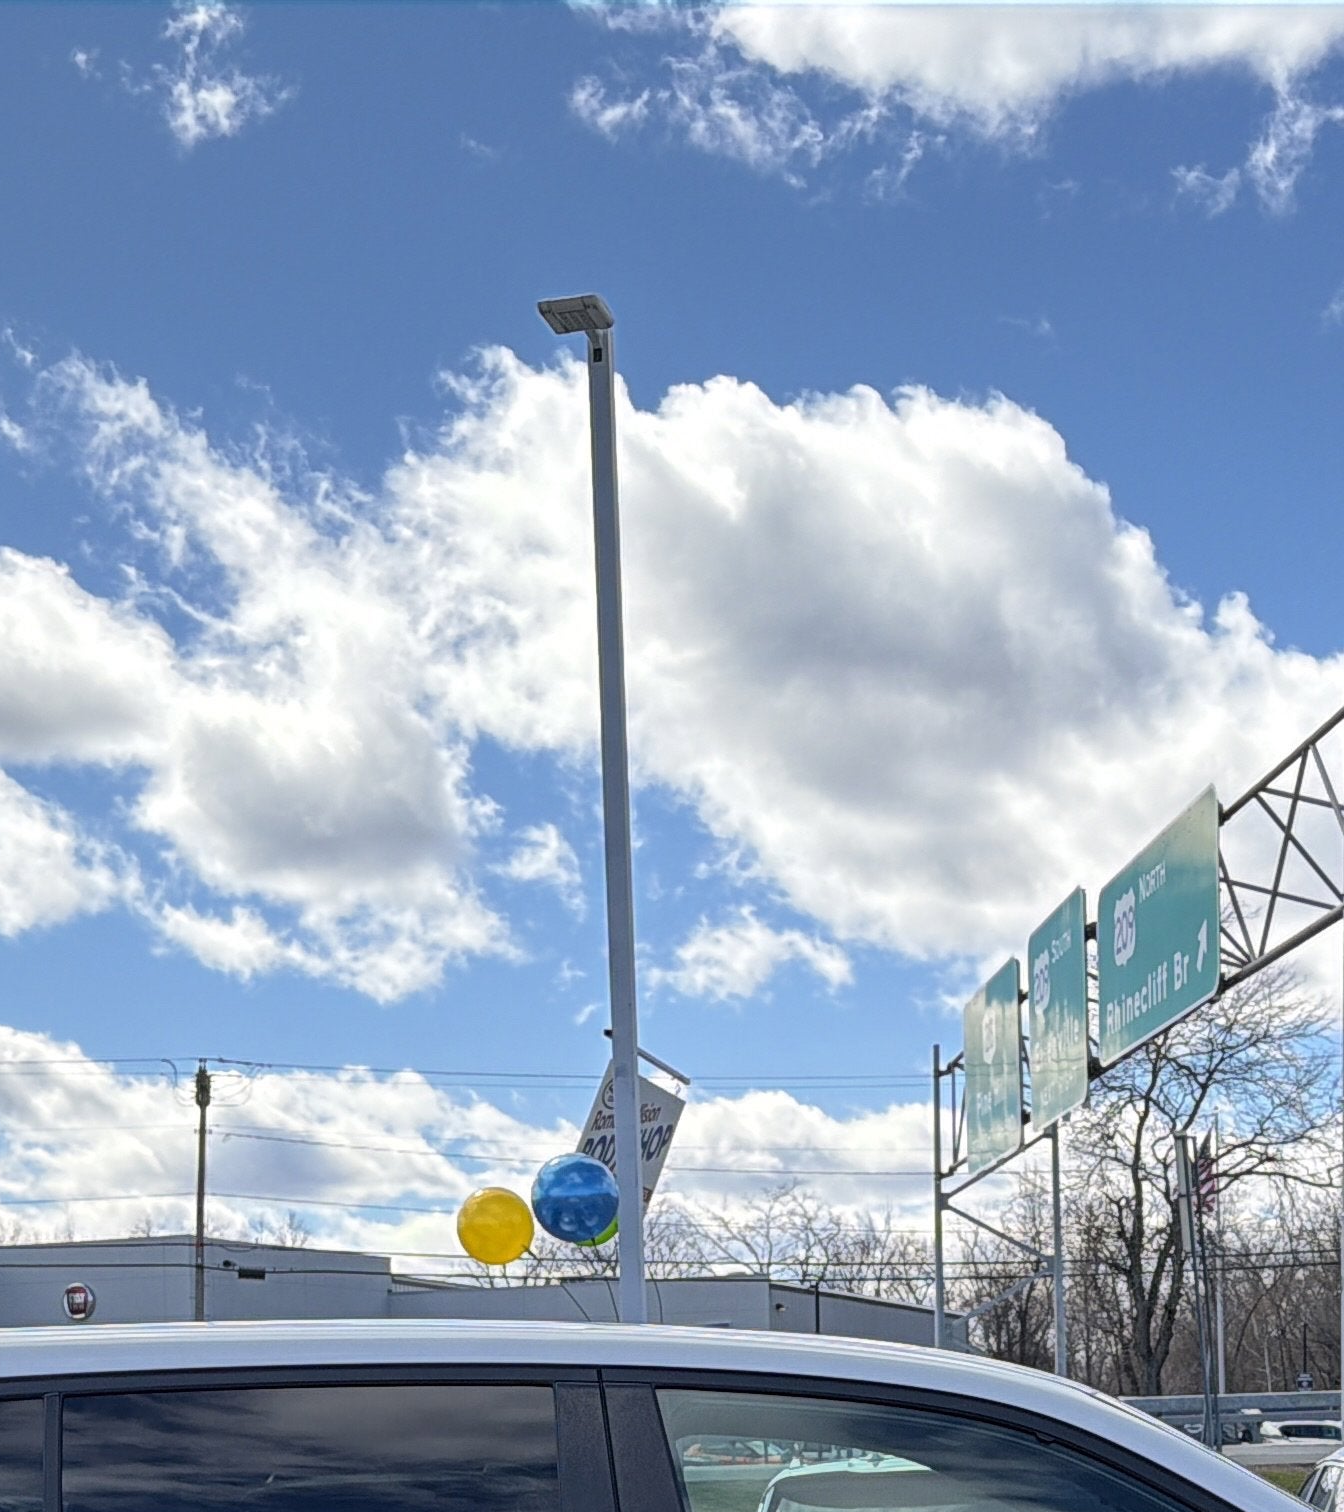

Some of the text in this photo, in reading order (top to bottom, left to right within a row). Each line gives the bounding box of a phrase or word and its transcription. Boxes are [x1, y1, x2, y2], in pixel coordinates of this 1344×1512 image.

[1139, 861, 1166, 903] NORTH
[1115, 905, 1134, 955] 209
[1106, 951, 1189, 1036] Rhinecliff Br
[582, 1125, 673, 1173] BOD HOP
